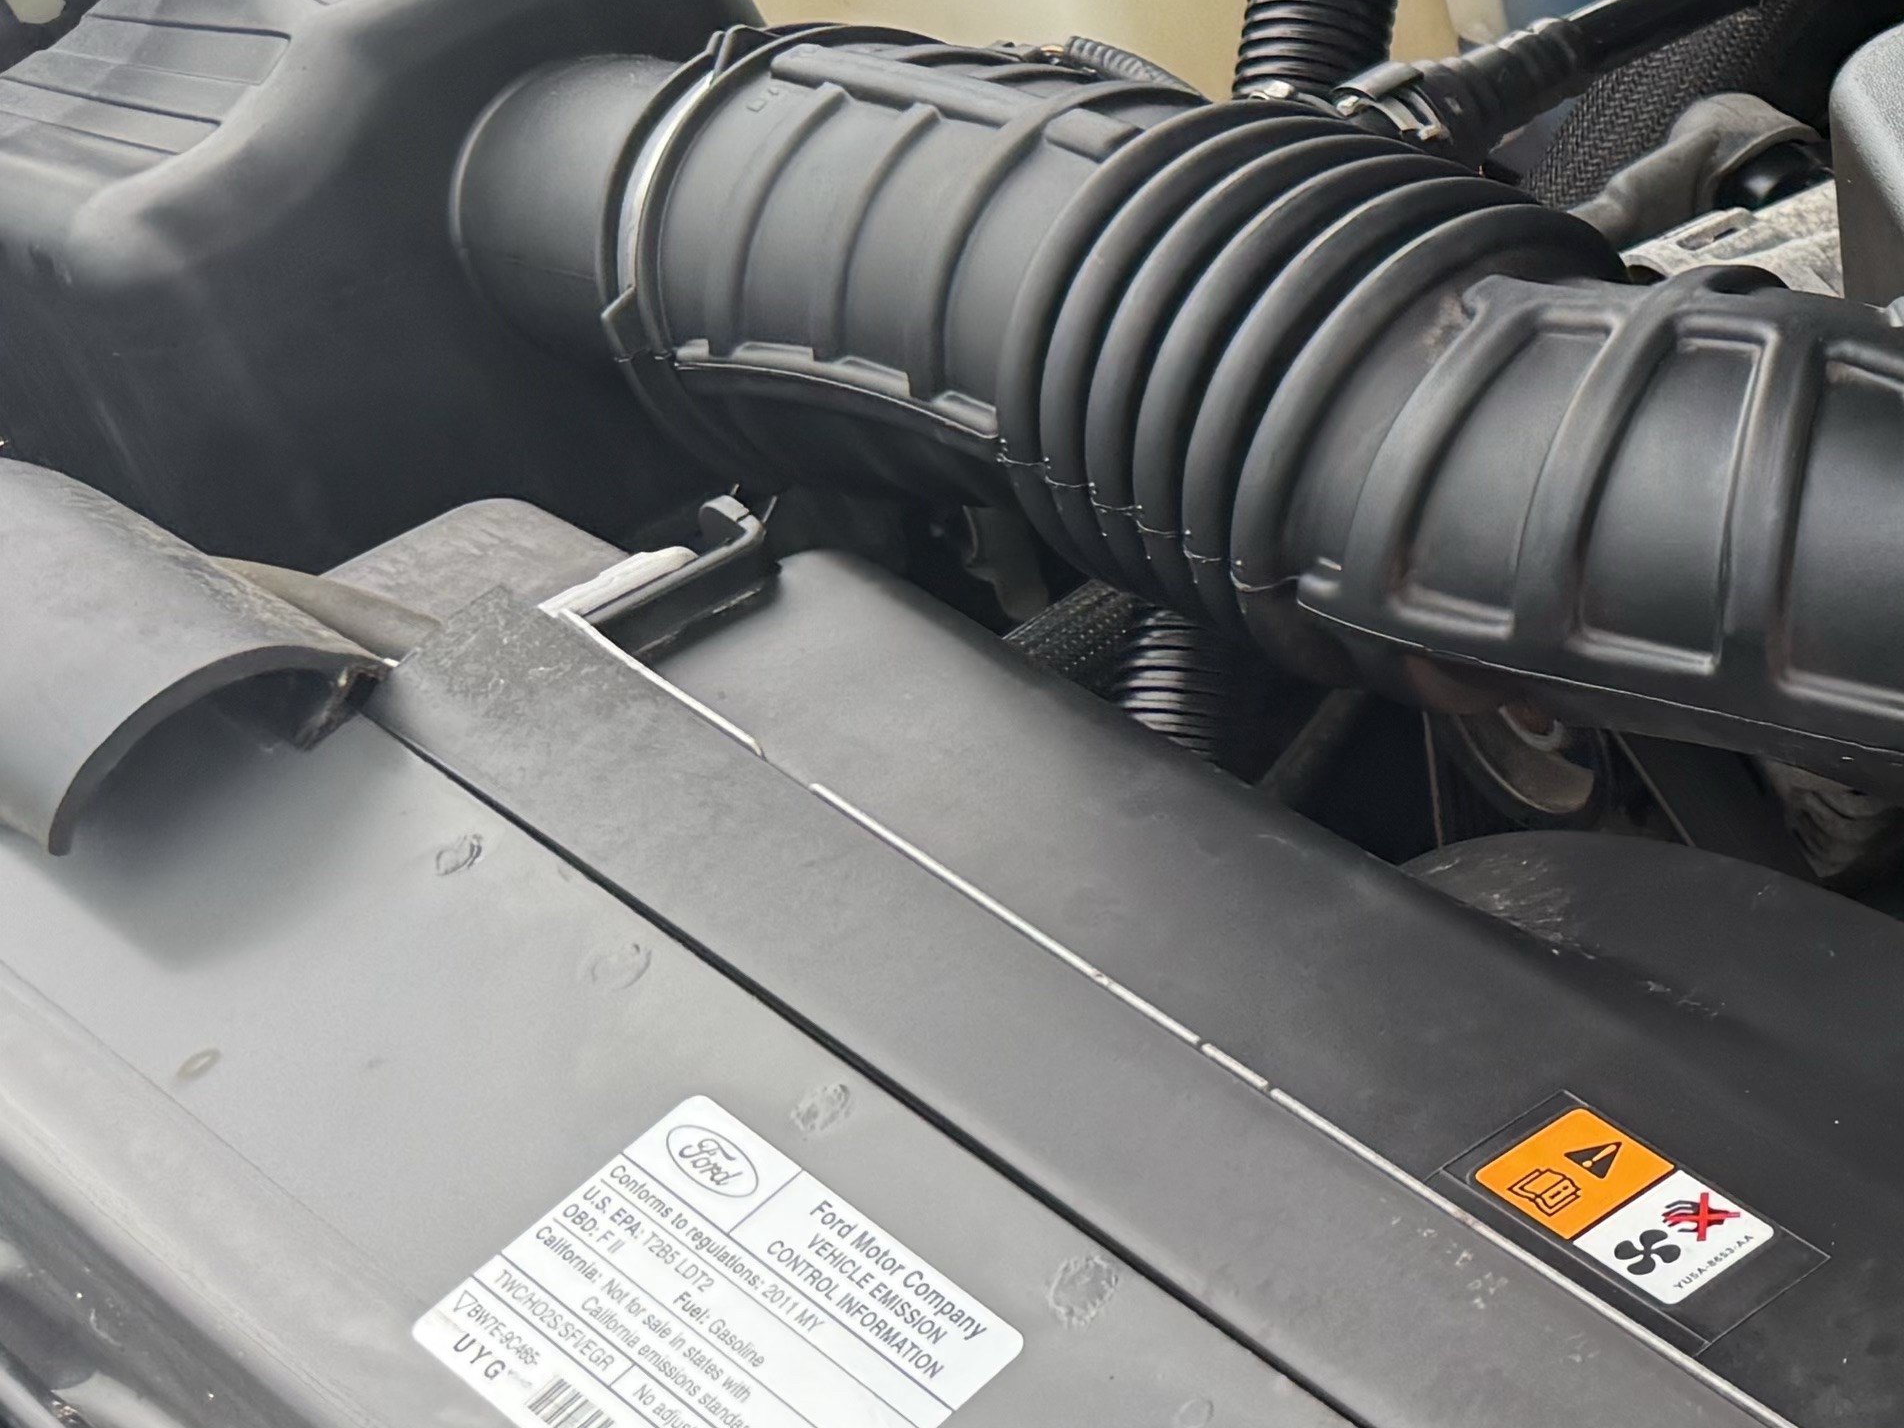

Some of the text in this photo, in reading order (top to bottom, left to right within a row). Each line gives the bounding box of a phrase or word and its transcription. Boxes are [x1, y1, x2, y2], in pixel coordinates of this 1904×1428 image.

[677, 1136, 746, 1189] Ford
[580, 1185, 716, 1293] U.S. EPA: T2B5 LDT2
[606, 1163, 825, 1333] Conforms to regulations: 2011 MY
[803, 1233, 949, 1345] VEHICLE EMISSION
[808, 1199, 992, 1344] Ford Motor Company
[532, 1224, 754, 1403] California: Not for sale in states with
[578, 1295, 645, 1349] California
[635, 1343, 703, 1398] emissions
[671, 1290, 769, 1369] Fuel: Gasoline
[763, 1238, 946, 1379] CONTROL INFORMATION
[631, 1383, 660, 1407] No
